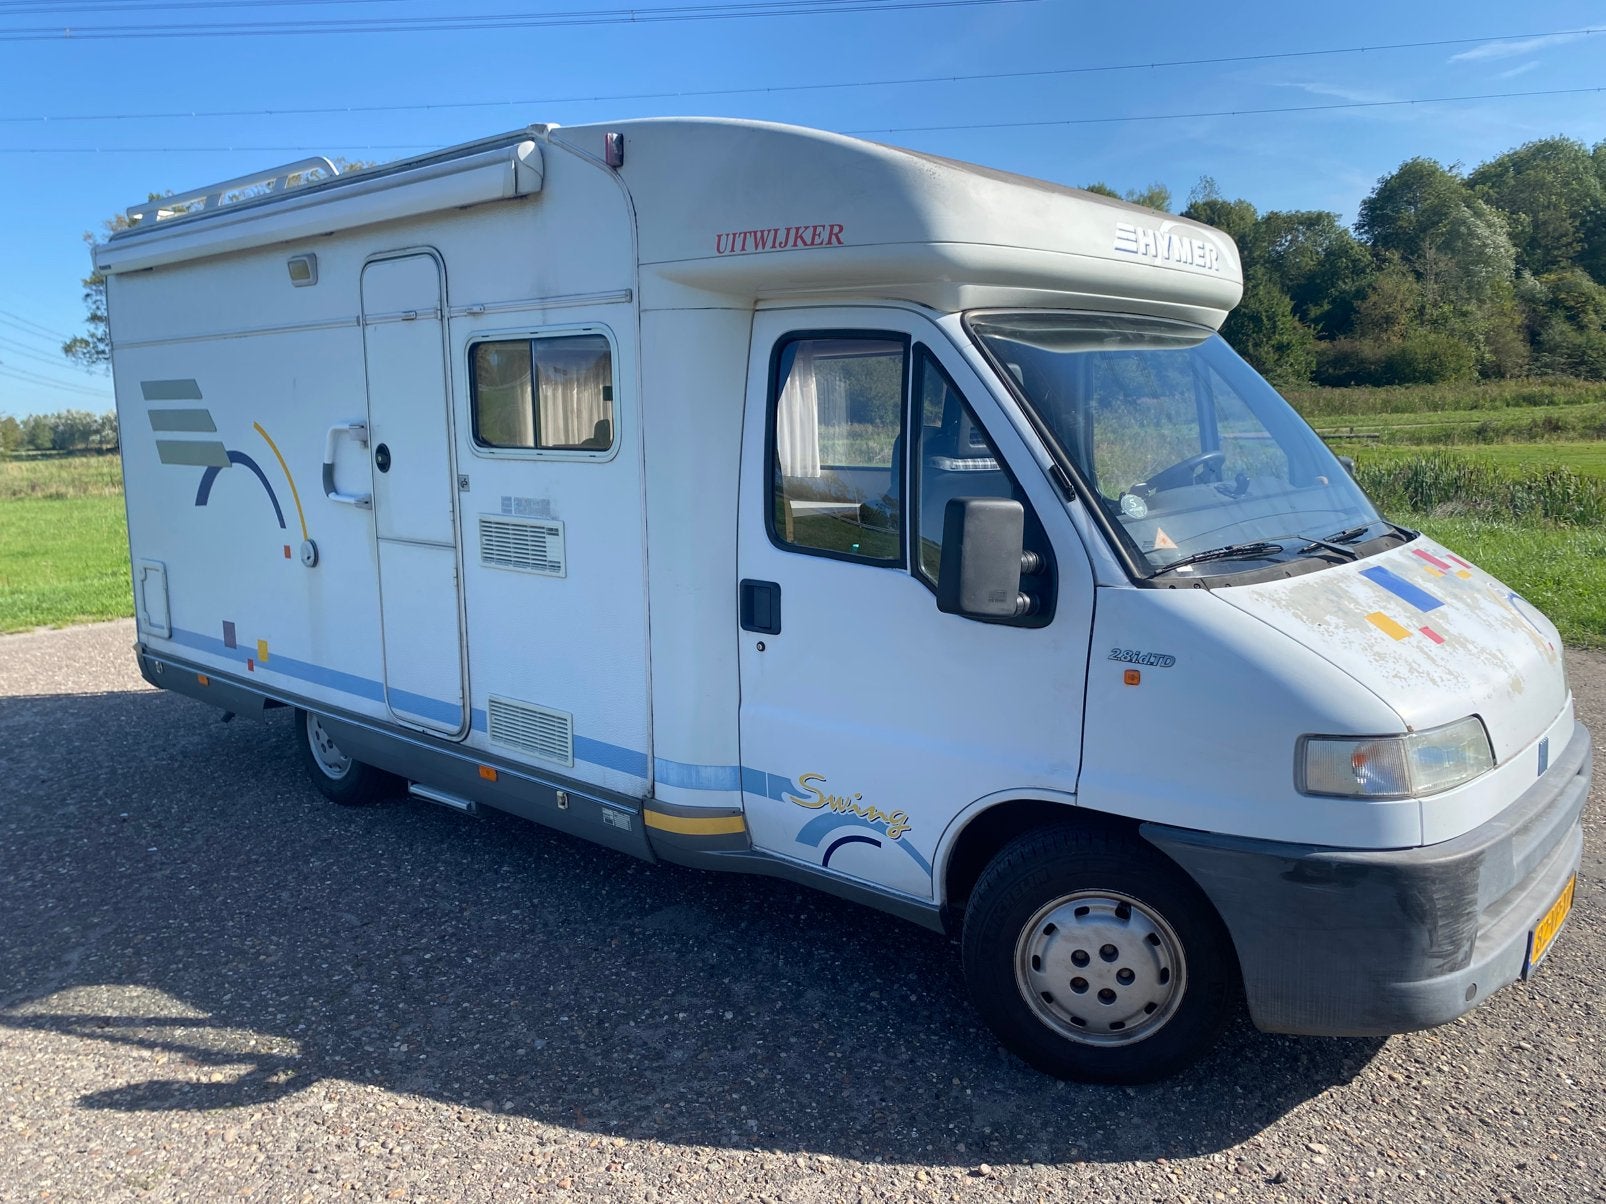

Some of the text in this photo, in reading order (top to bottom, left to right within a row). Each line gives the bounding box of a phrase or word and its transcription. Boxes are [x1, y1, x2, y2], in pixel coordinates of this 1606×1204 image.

[716, 223, 844, 254] UITWIJKER
[1135, 226, 1219, 271] HYMER
[789, 772, 912, 840] Swing
